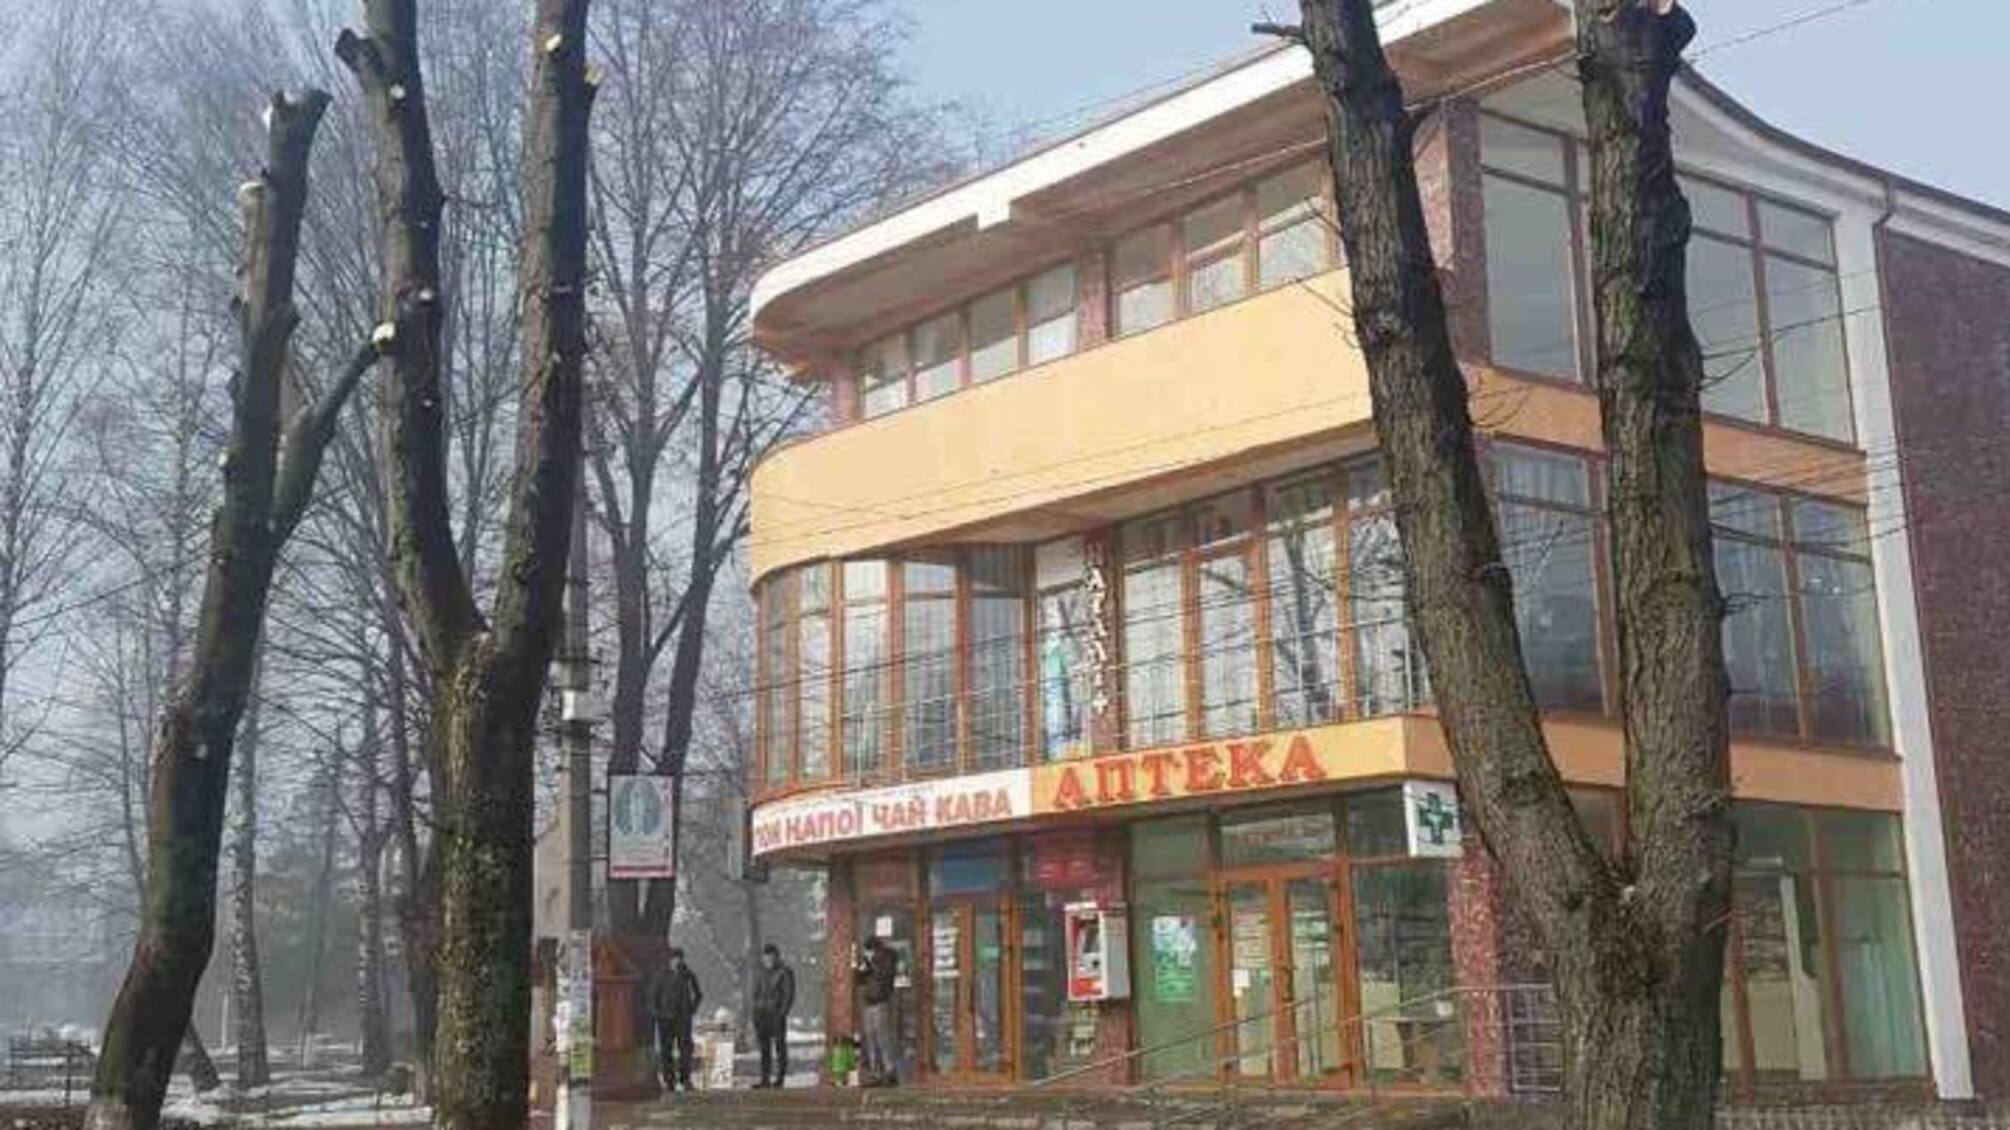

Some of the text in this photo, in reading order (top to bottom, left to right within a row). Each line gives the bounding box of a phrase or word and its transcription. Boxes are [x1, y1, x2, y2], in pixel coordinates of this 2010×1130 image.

[1054, 731, 1327, 809] АПТЕКА
[786, 800, 863, 841] НАПОЇ
[873, 794, 926, 830] ЧАЙ
[934, 788, 1013, 822] КАВА
